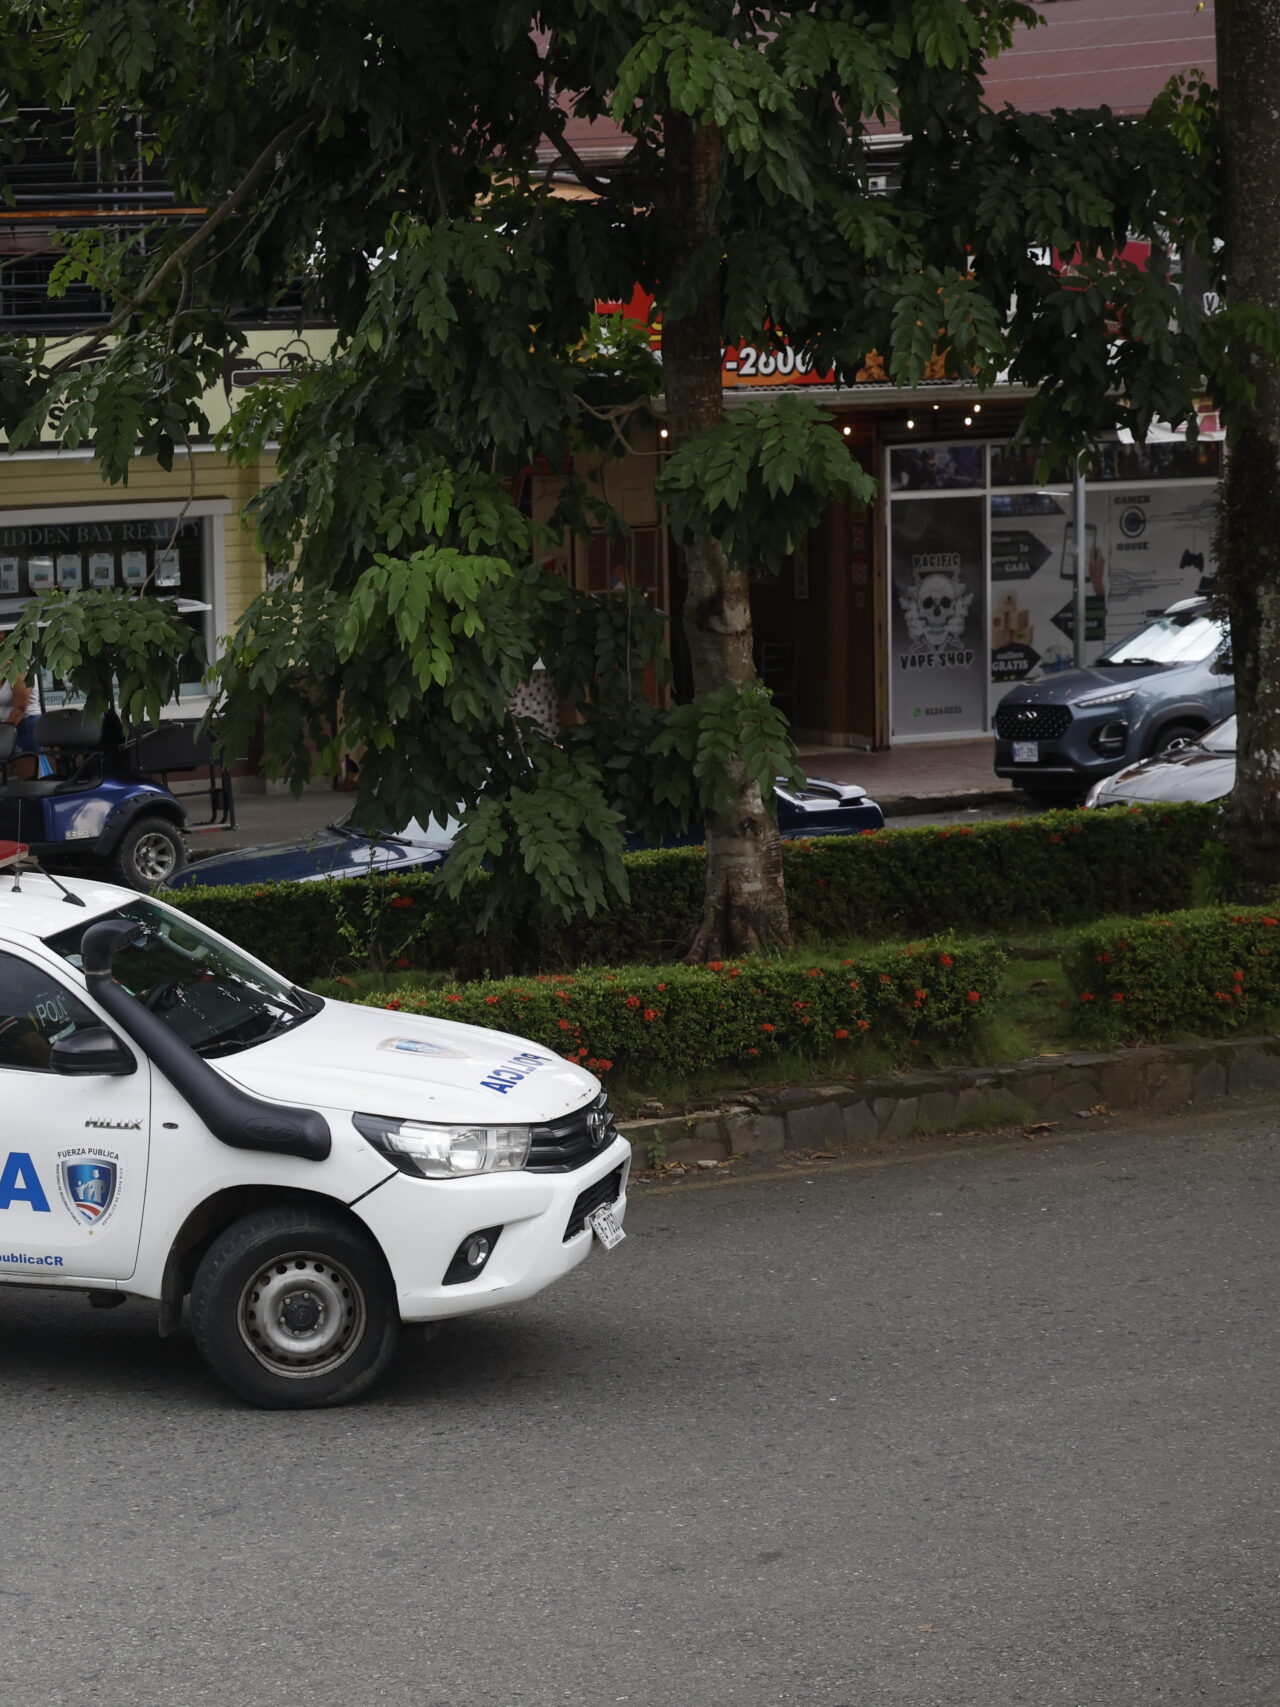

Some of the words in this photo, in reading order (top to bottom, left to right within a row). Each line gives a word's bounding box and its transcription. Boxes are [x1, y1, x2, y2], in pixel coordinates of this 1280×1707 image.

[76, 524, 120, 543] BAY
[57, 1147, 86, 1159] FUERZA
[88, 1147, 120, 1161] PUBLICA
